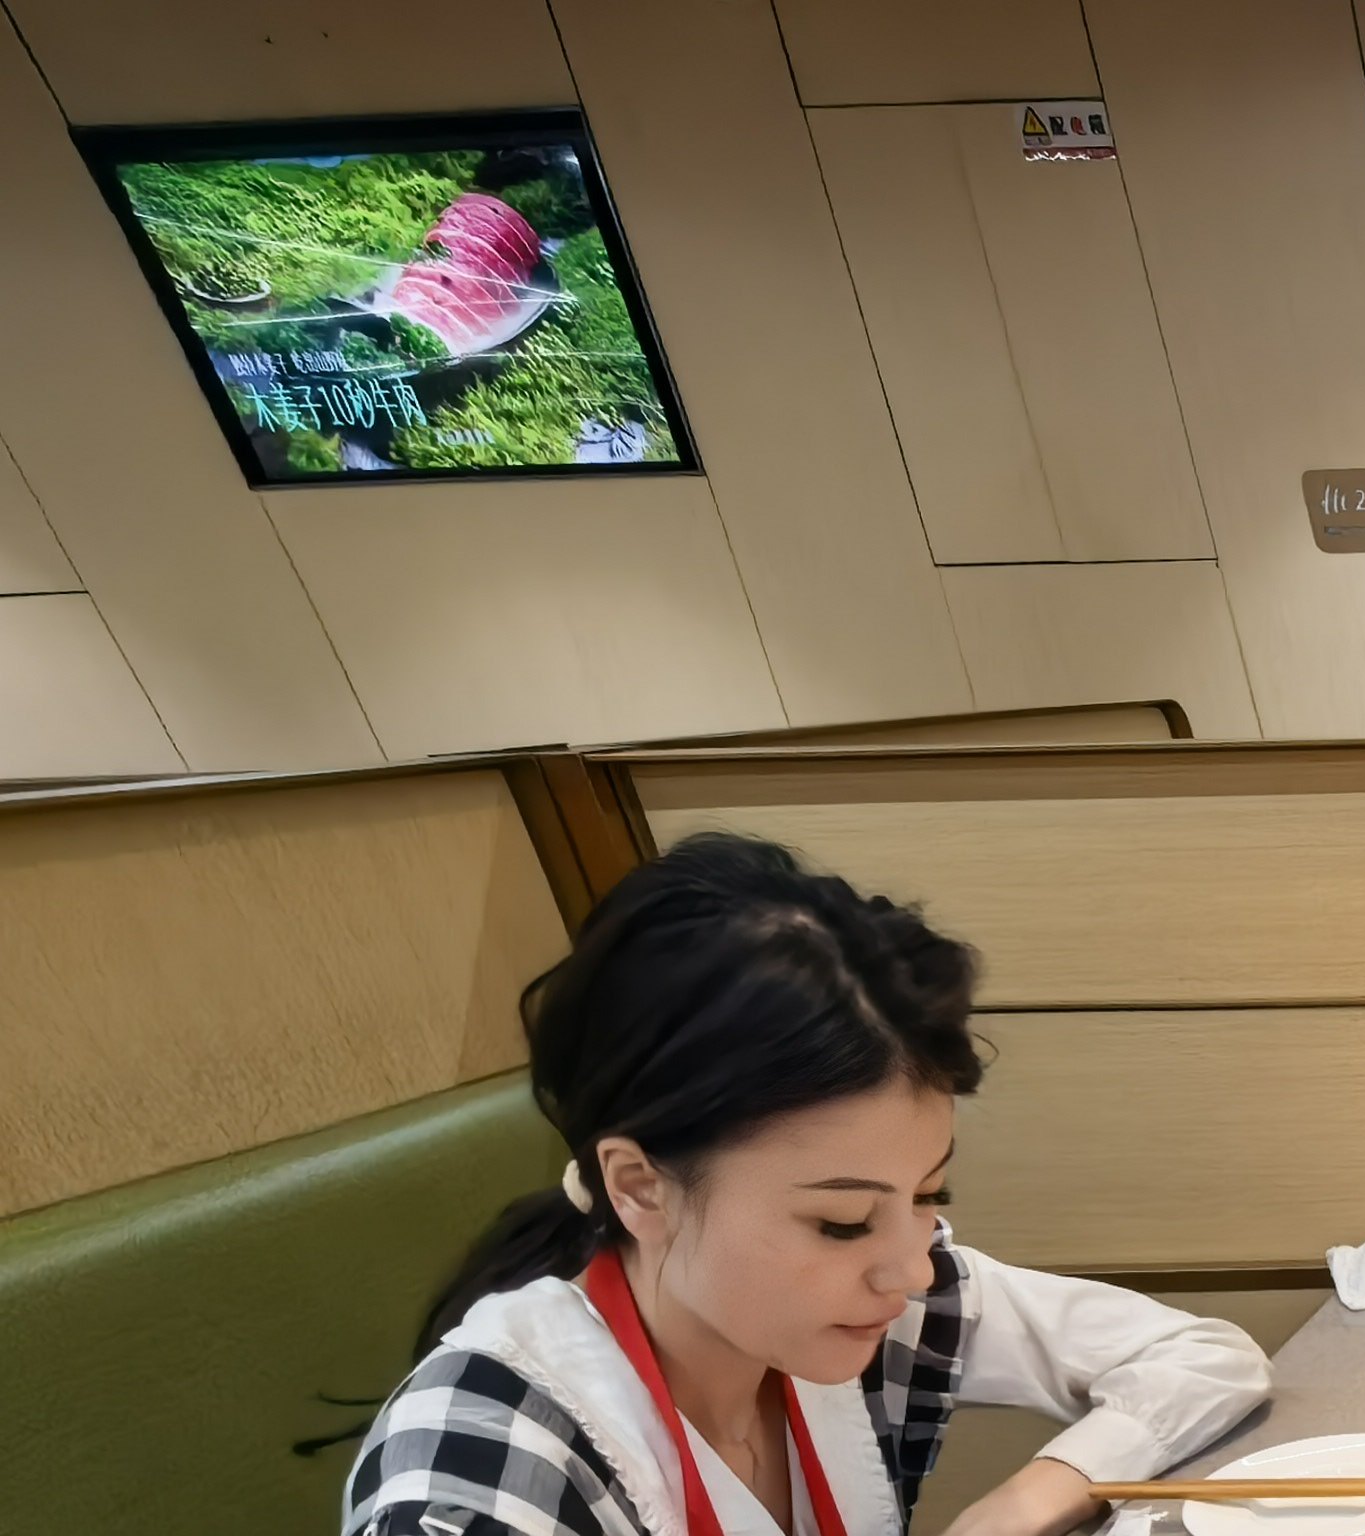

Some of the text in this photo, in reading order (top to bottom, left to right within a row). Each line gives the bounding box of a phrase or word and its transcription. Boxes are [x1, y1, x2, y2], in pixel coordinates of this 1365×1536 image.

[245, 378, 428, 433] 木姜子10秒牛肉
